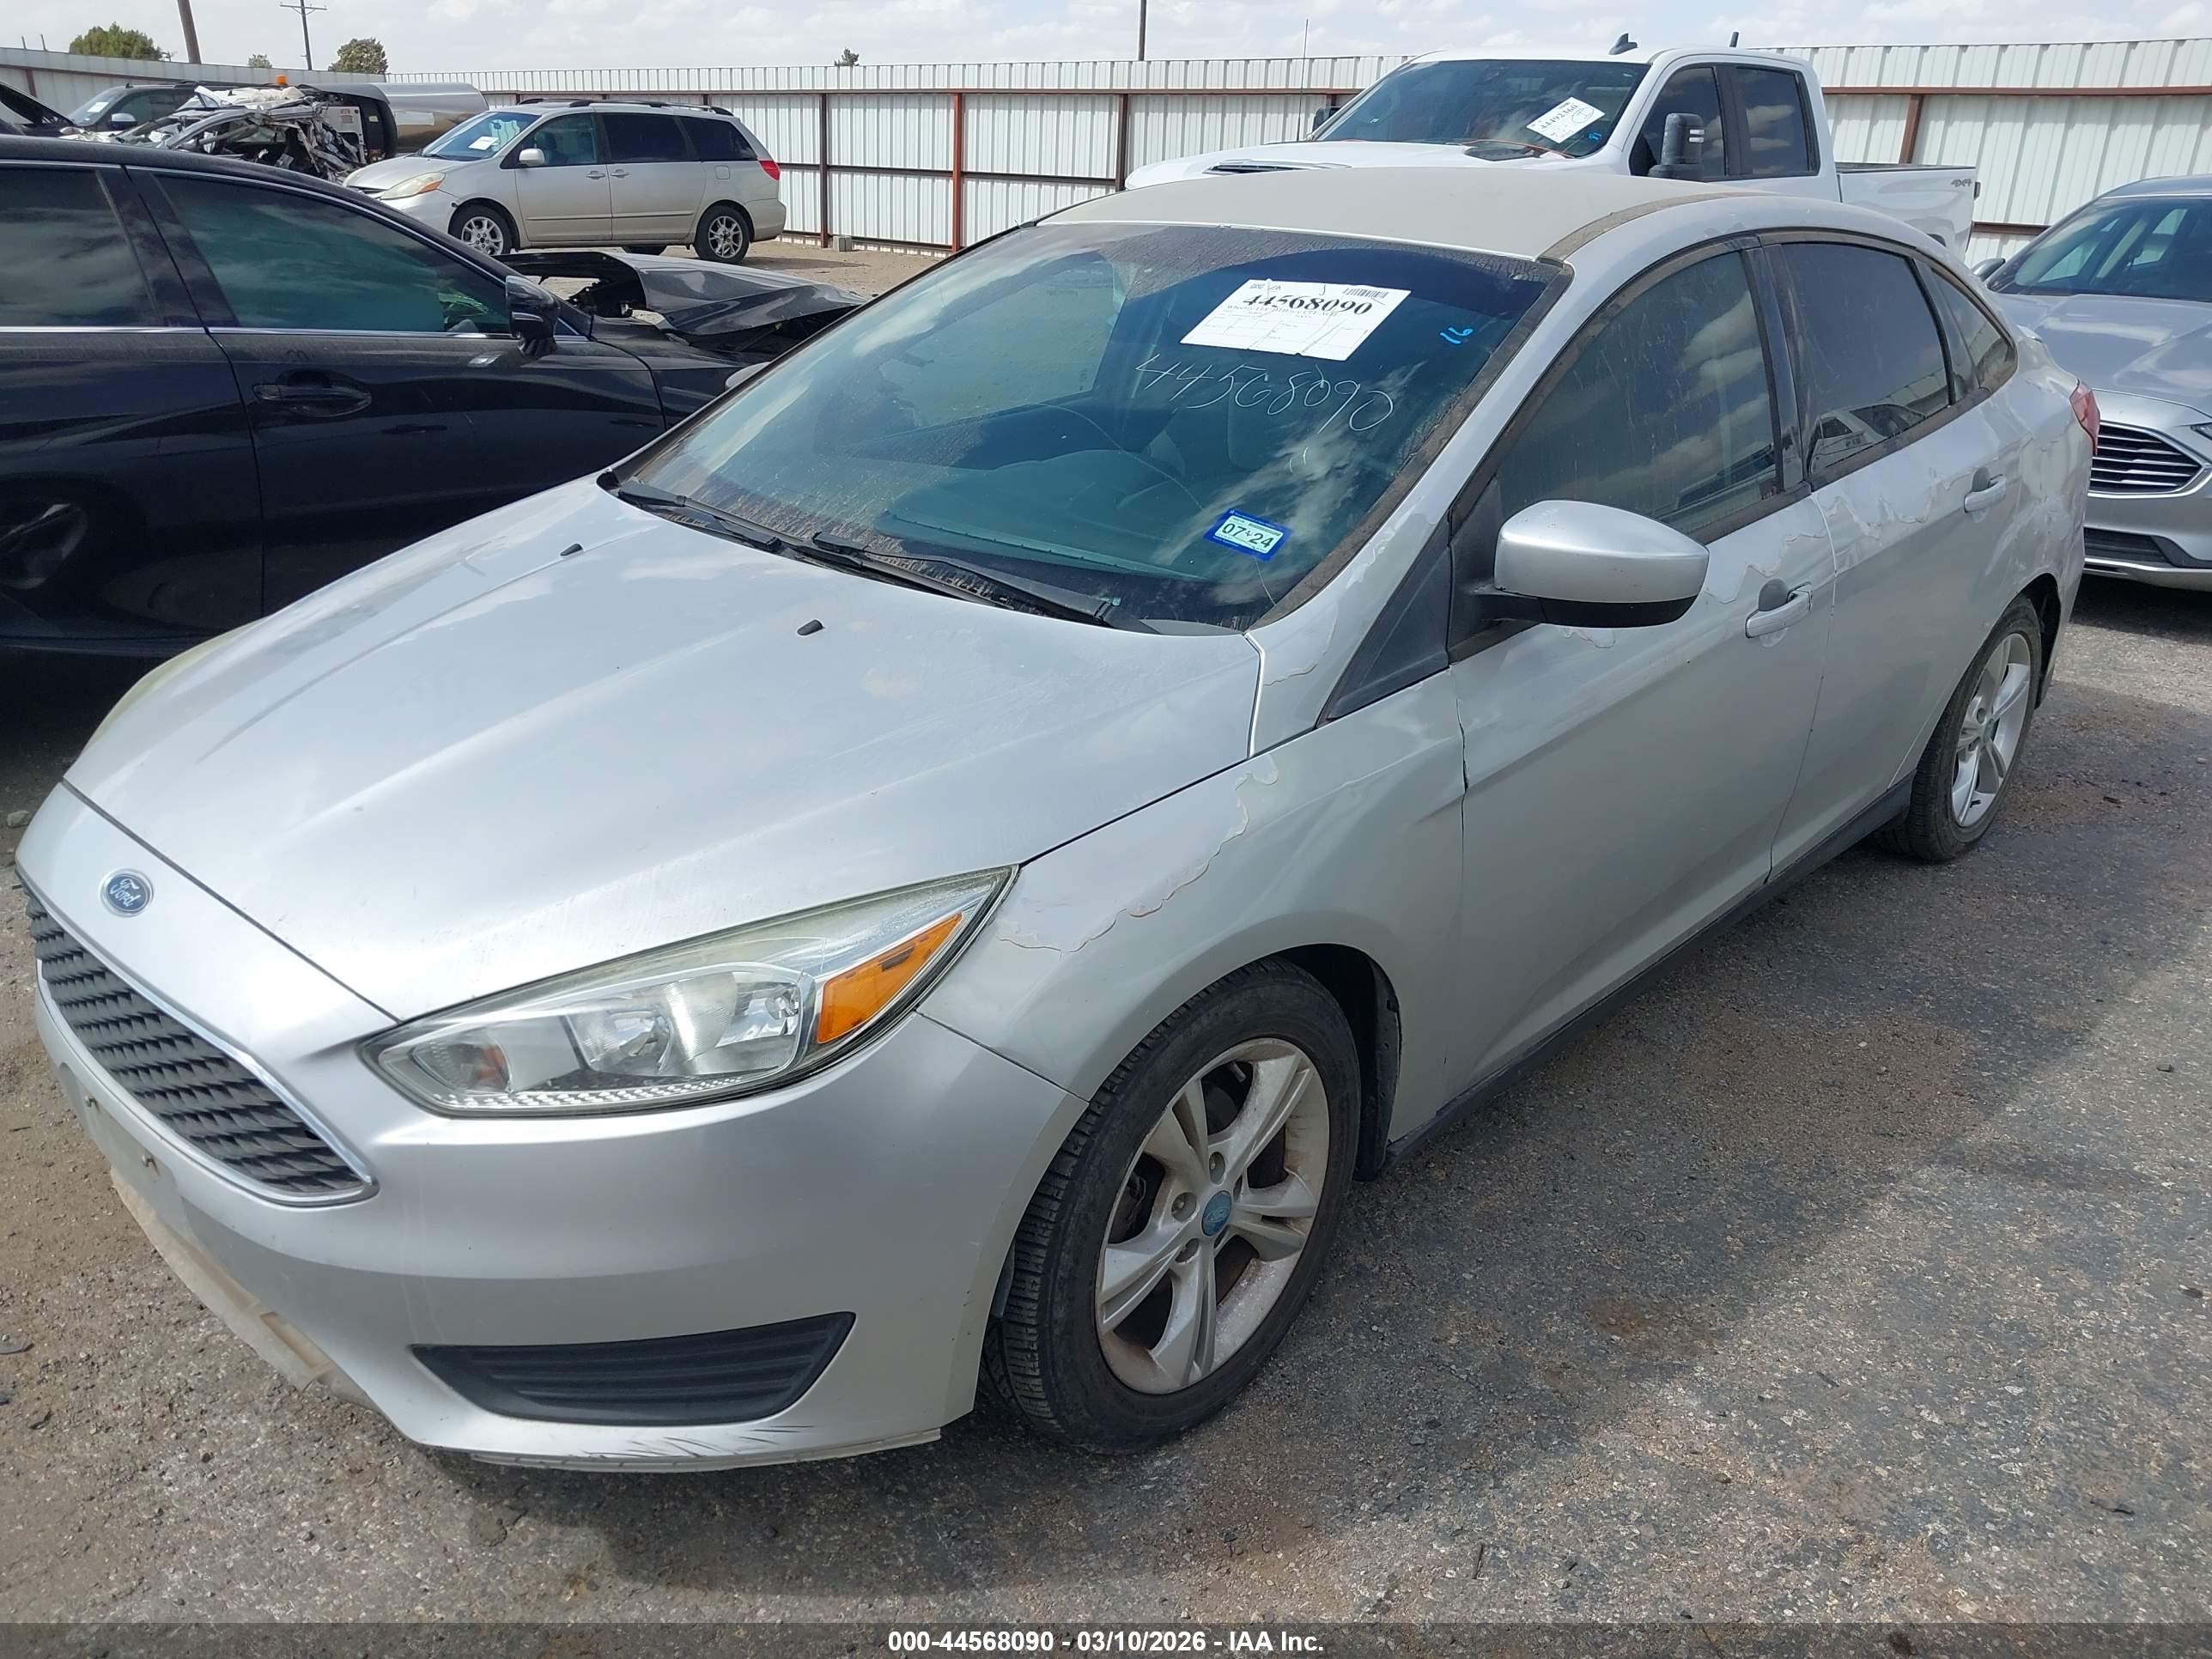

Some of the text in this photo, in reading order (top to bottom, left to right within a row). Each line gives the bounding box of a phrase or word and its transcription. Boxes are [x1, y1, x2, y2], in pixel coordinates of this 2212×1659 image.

[1242, 294, 1374, 316] 44568090
[1439, 326, 1474, 344] 16
[1134, 353, 1395, 435] 44568090
[1221, 522, 1247, 538] 07
[1248, 532, 1275, 549] 24
[108, 877, 143, 908] Ford
